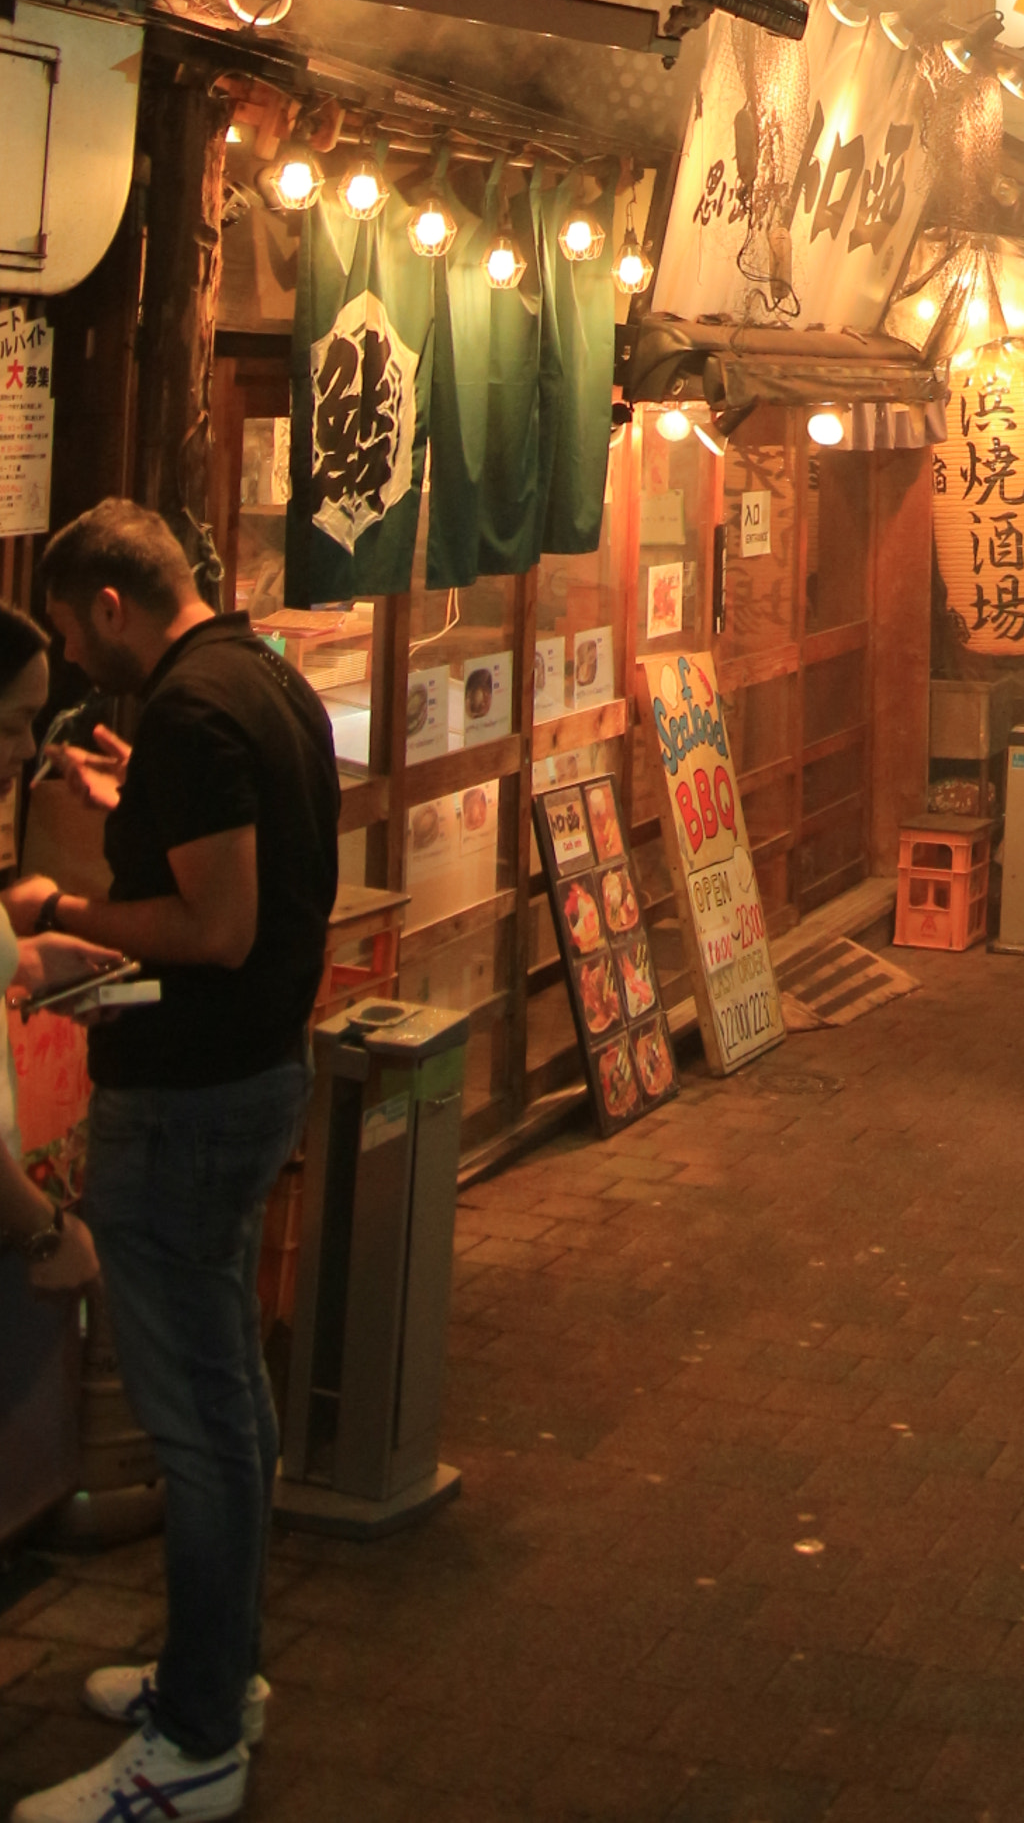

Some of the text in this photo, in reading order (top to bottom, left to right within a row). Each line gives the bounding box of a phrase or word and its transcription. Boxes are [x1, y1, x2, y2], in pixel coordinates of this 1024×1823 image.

[6, 359, 49, 390] 大募集
[745, 503, 760, 526] 入口
[676, 765, 737, 855] BBQ
[692, 871, 732, 915] OPEN
